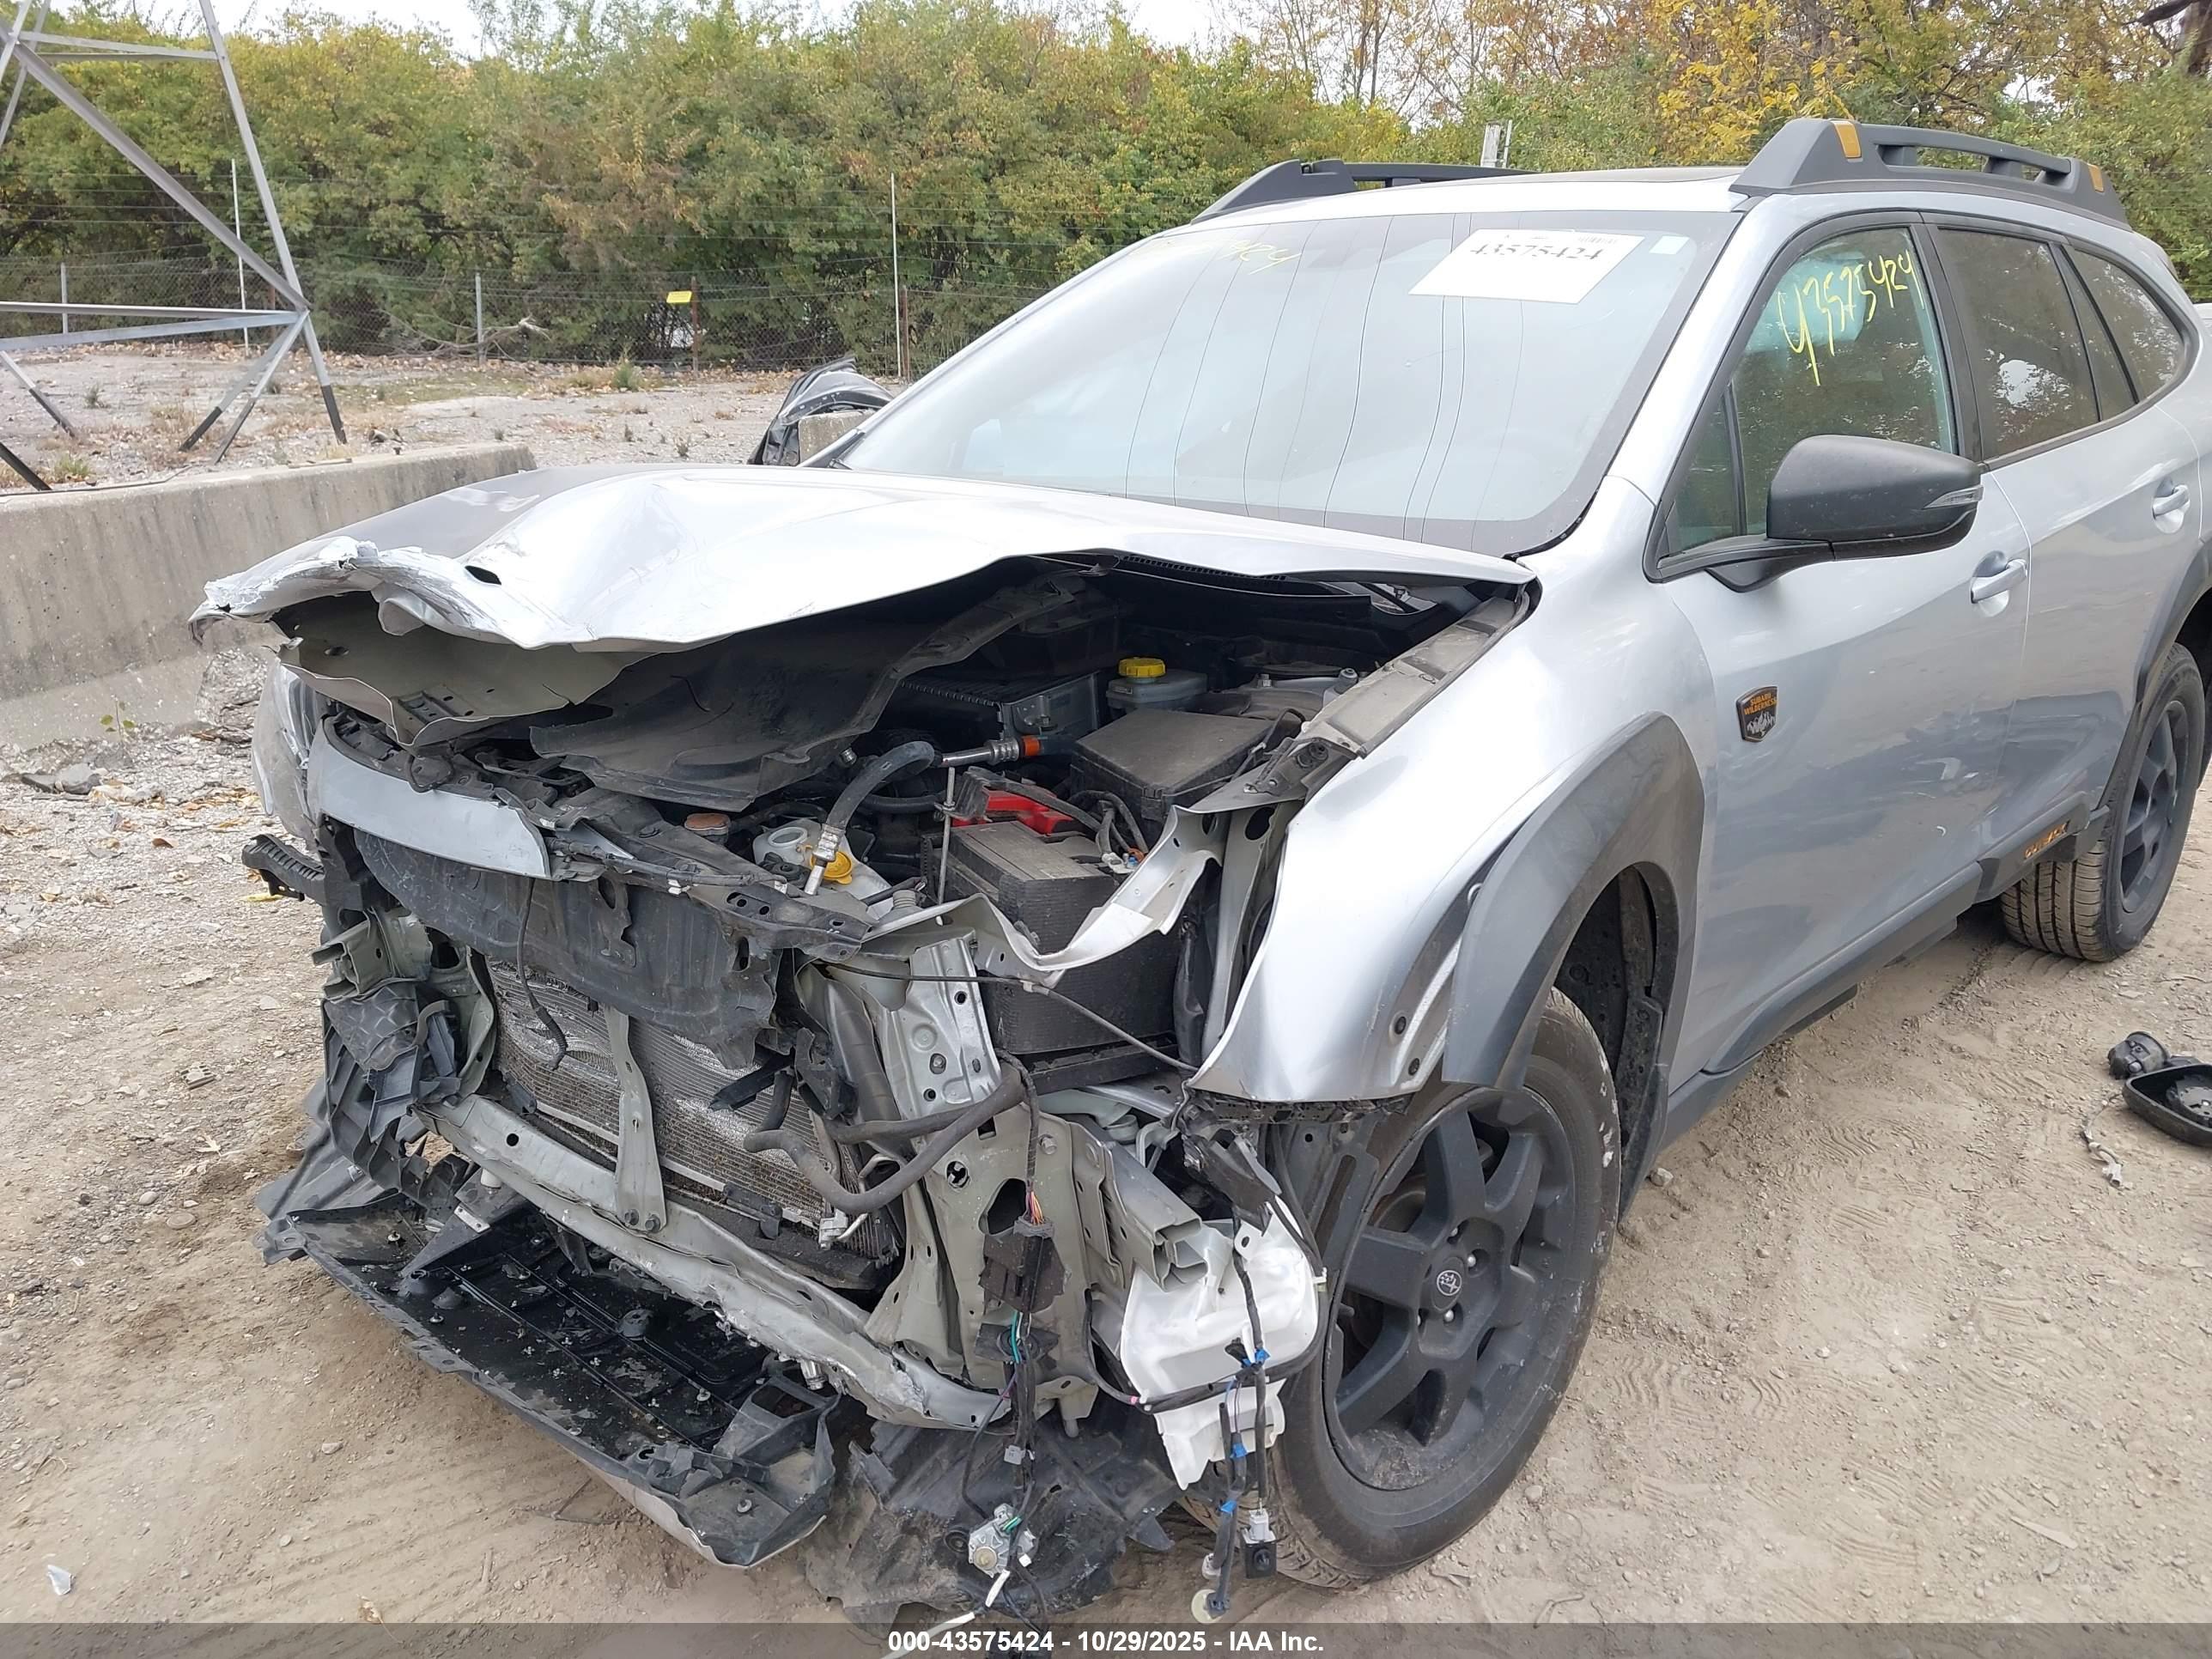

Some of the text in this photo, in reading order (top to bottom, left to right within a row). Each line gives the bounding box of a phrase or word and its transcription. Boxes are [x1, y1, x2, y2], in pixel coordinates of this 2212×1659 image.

[1469, 243, 1604, 260] 43575424
[1777, 249, 1925, 386] 43575424
[1744, 697, 1778, 715] WILDERNESS
[1750, 692, 1771, 706] SUBARU
